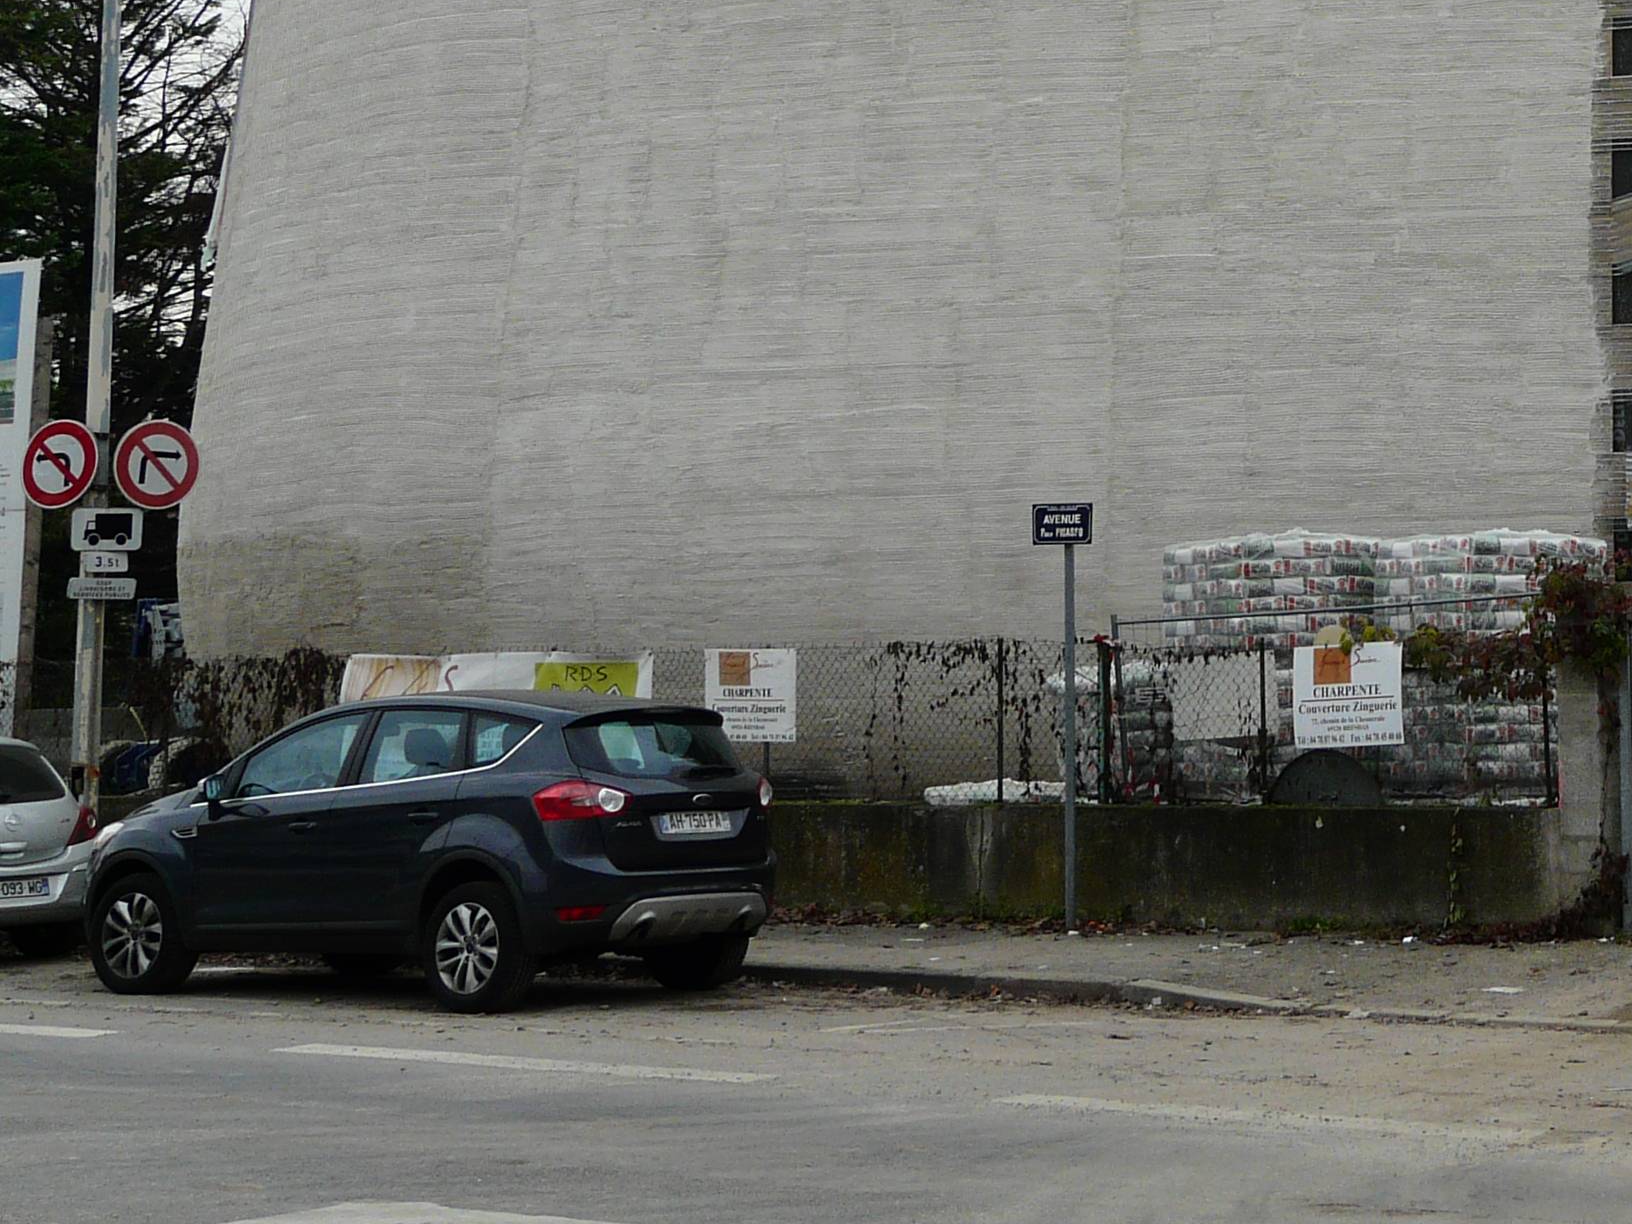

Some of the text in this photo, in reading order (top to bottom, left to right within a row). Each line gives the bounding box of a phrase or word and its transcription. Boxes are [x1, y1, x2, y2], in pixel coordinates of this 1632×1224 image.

[1043, 514, 1082, 525] AVENUE
[722, 688, 773, 697] CHARPENTE
[1313, 683, 1382, 698] CHARPENTE
[1298, 700, 1397, 715] Couverture Zinguerie
